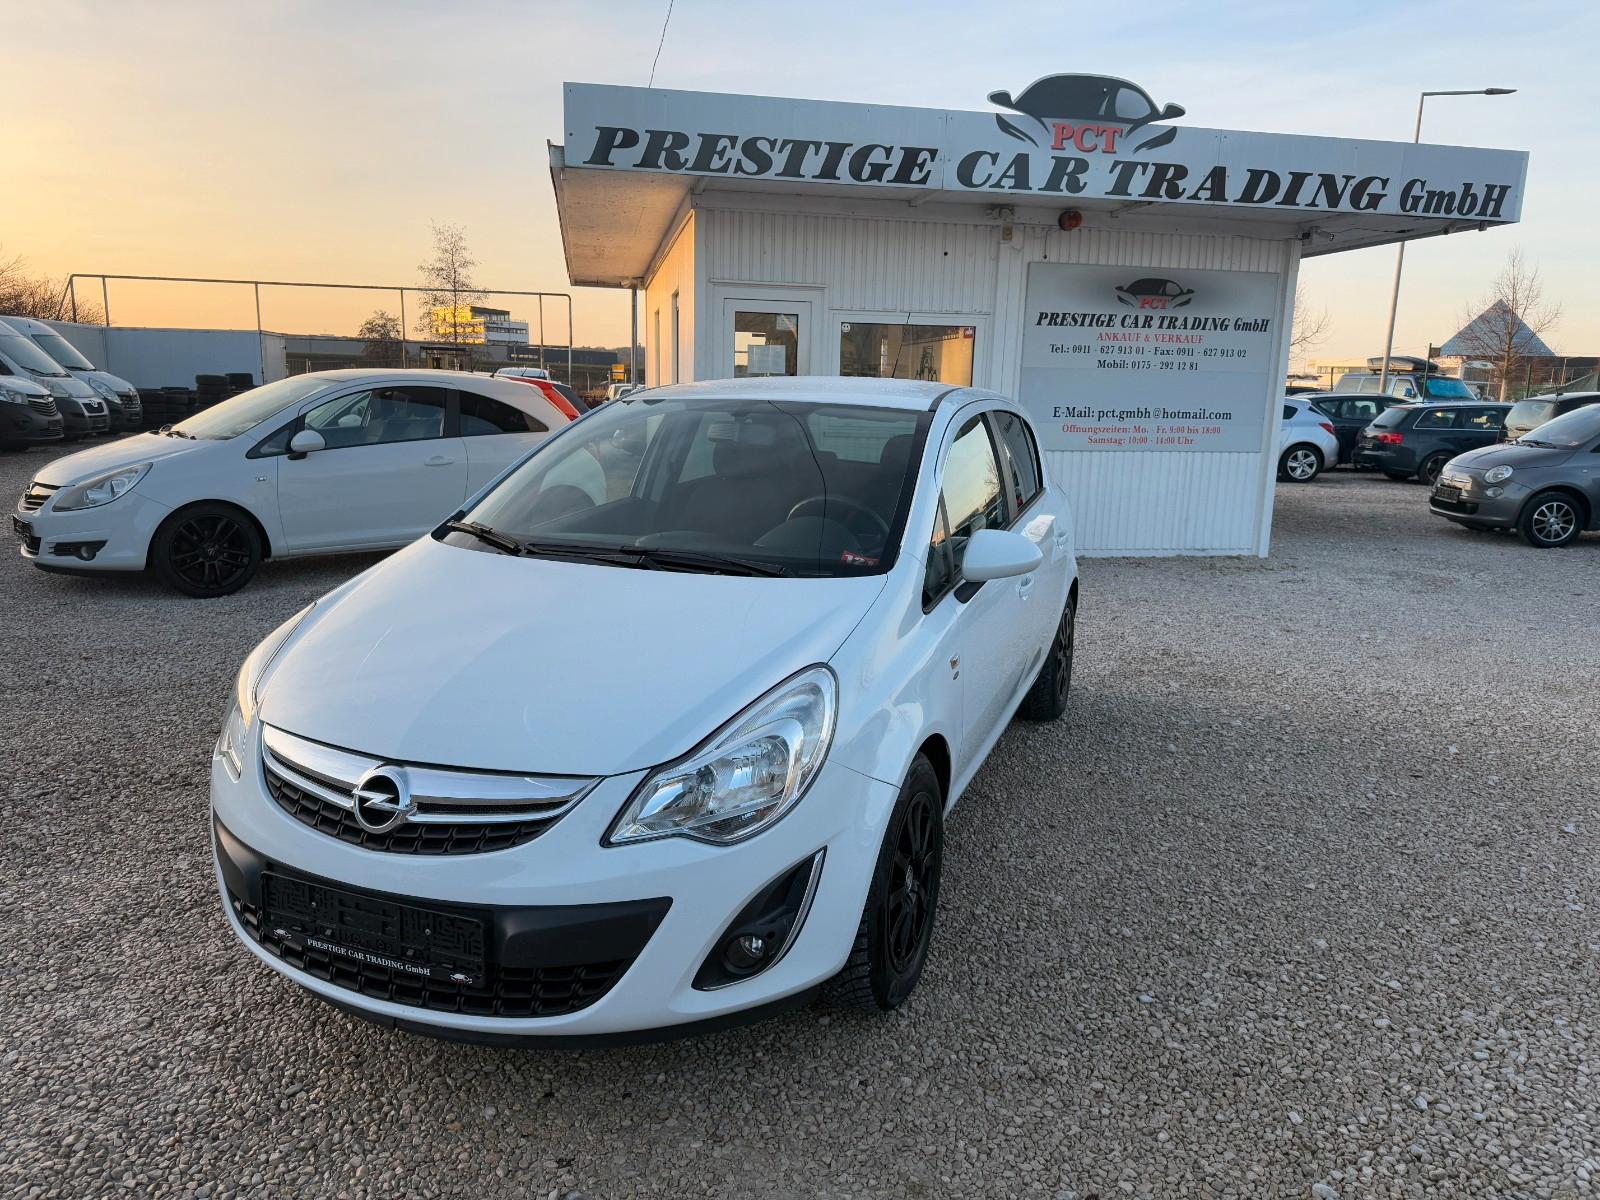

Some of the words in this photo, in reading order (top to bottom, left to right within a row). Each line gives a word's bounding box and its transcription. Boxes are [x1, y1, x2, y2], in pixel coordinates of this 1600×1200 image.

[1050, 122, 1123, 154] PCT
[583, 125, 938, 185] PRESTIGE
[956, 150, 1090, 194] CAR
[1104, 160, 1390, 211] TRADING
[1399, 178, 1512, 218] GmbH
[1139, 297, 1169, 309] PCT
[1035, 311, 1117, 328] PRESTIGE
[1120, 313, 1154, 329] CAR
[1156, 315, 1231, 331] TRADING
[1233, 317, 1270, 333] GmbH
[1096, 332, 1141, 342] ANKAUF
[1154, 333, 1205, 344] VERKAUF
[1049, 344, 1070, 353] Tel.:
[1072, 344, 1091, 354] 0911
[1100, 345, 1115, 354] 627
[1117, 345, 1133, 355] 913
[1135, 346, 1145, 355] 01
[1153, 346, 1174, 356] Fax:
[1176, 347, 1194, 357] 0911
[1203, 348, 1218, 357] 627
[1220, 348, 1235, 358] 913
[1237, 349, 1247, 358] 02
[1096, 360, 1129, 369] Mobil:
[1131, 360, 1151, 370] 0175
[1159, 361, 1174, 370] 292
[1177, 362, 1186, 370] 12
[1189, 362, 1198, 371] 81
[1052, 406, 1095, 418] E-Mail:
[1097, 407, 1232, 422] pct.gmbh@hotmail.com
[1062, 422, 1131, 435] Öffnungszeiten:
[1156, 425, 1168, 434] Fr.
[1169, 426, 1185, 434] 9:00
[1187, 426, 1199, 434] bis
[1201, 426, 1221, 435] 18:00
[1087, 435, 1126, 446] Samstag:
[1128, 436, 1148, 445] 10:00
[1177, 437, 1194, 445] Uhr
[307, 938, 347, 956] PRESTIGE
[348, 949, 364, 961] CAR
[365, 953, 404, 970] TRADING
[405, 962, 431, 976] GmbH
